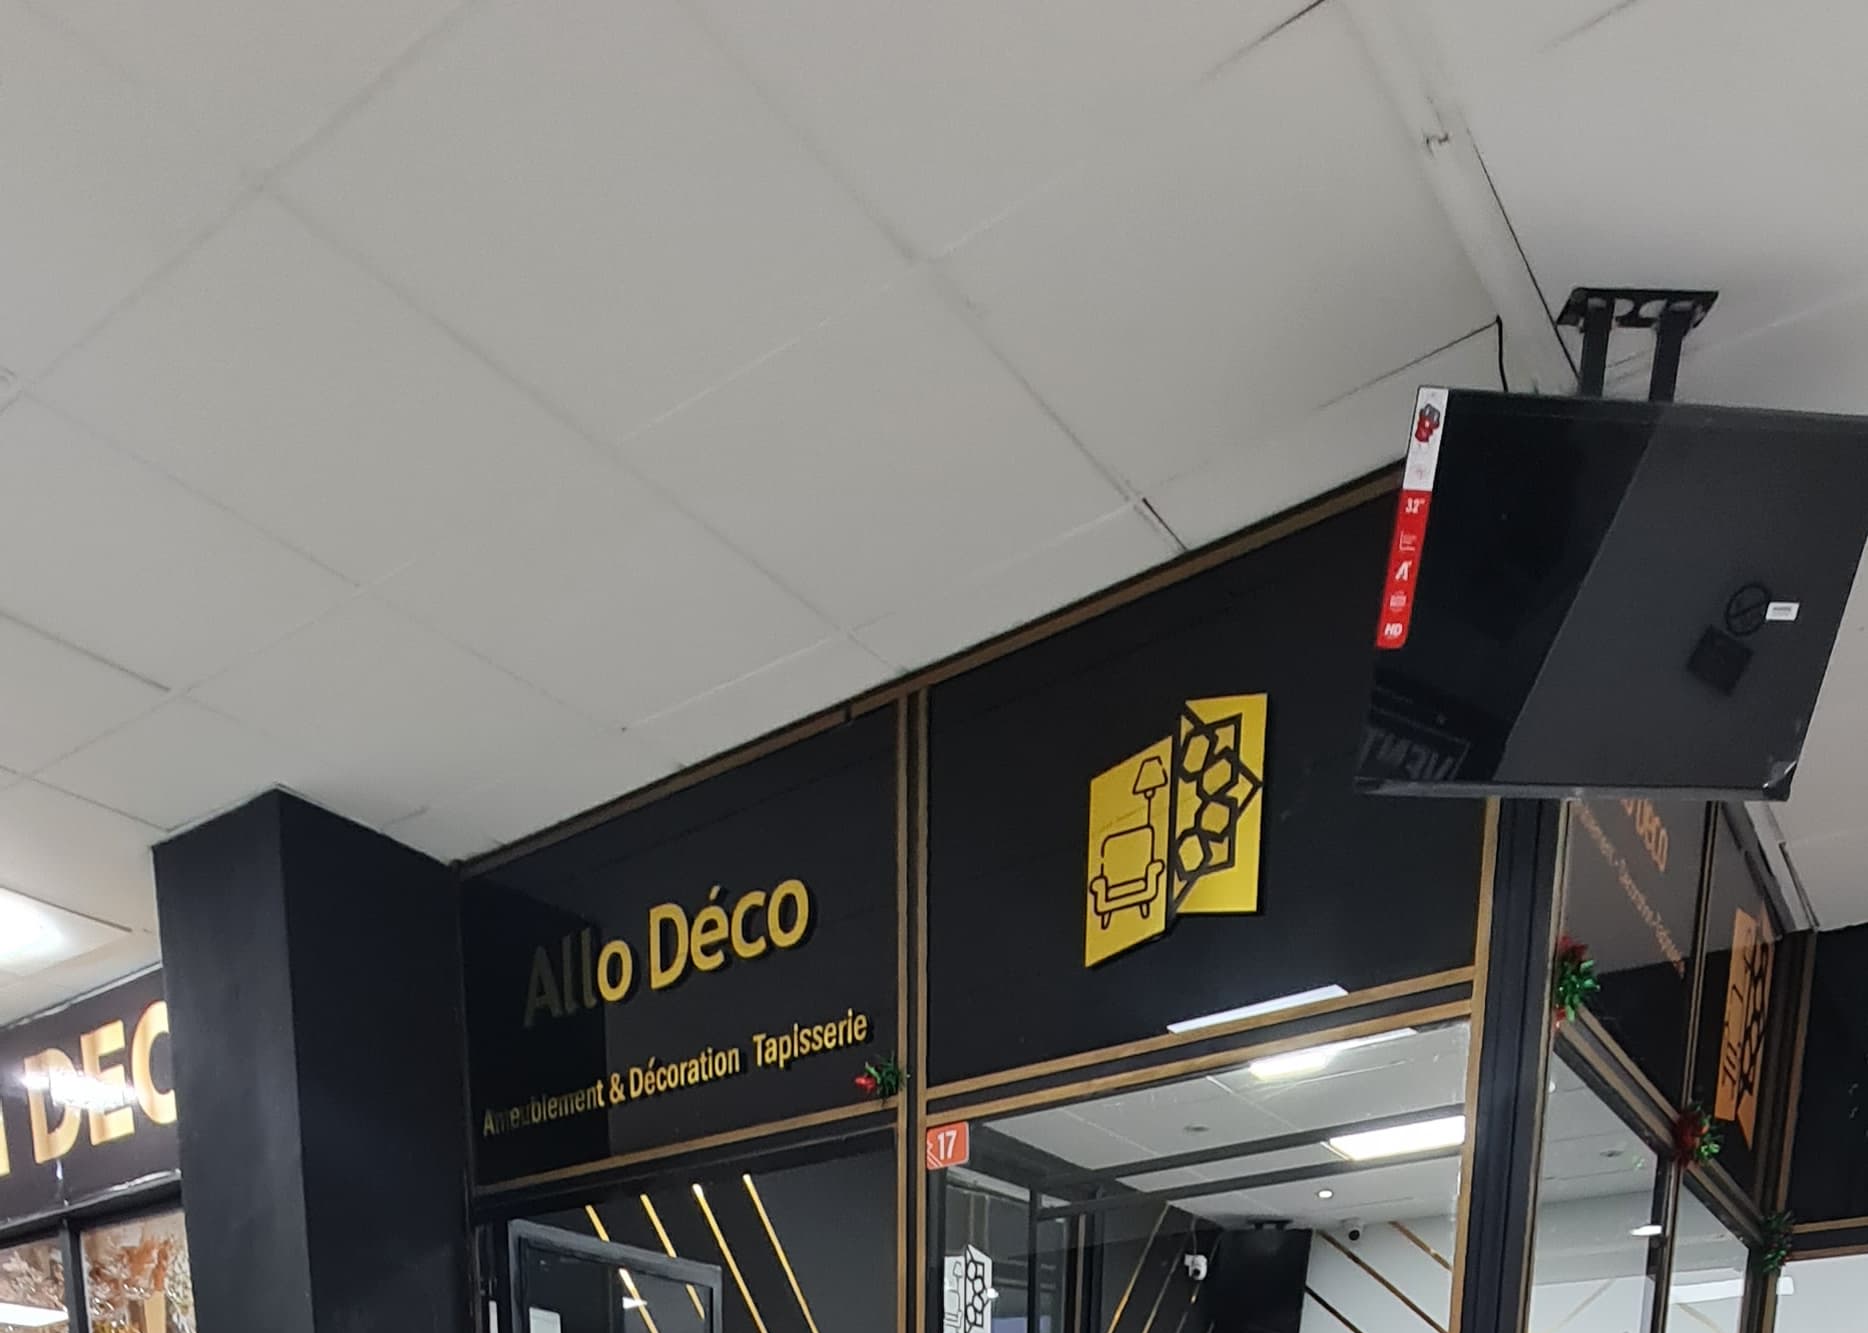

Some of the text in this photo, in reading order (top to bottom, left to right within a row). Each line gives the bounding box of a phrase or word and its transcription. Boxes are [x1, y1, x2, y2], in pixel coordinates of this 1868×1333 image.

[523, 879, 809, 1028] Allo Déco
[609, 1073, 625, 1104] &
[629, 1047, 740, 1100] Décoration
[752, 1008, 868, 1069] Tapisserie
[937, 1129, 957, 1160] 17
